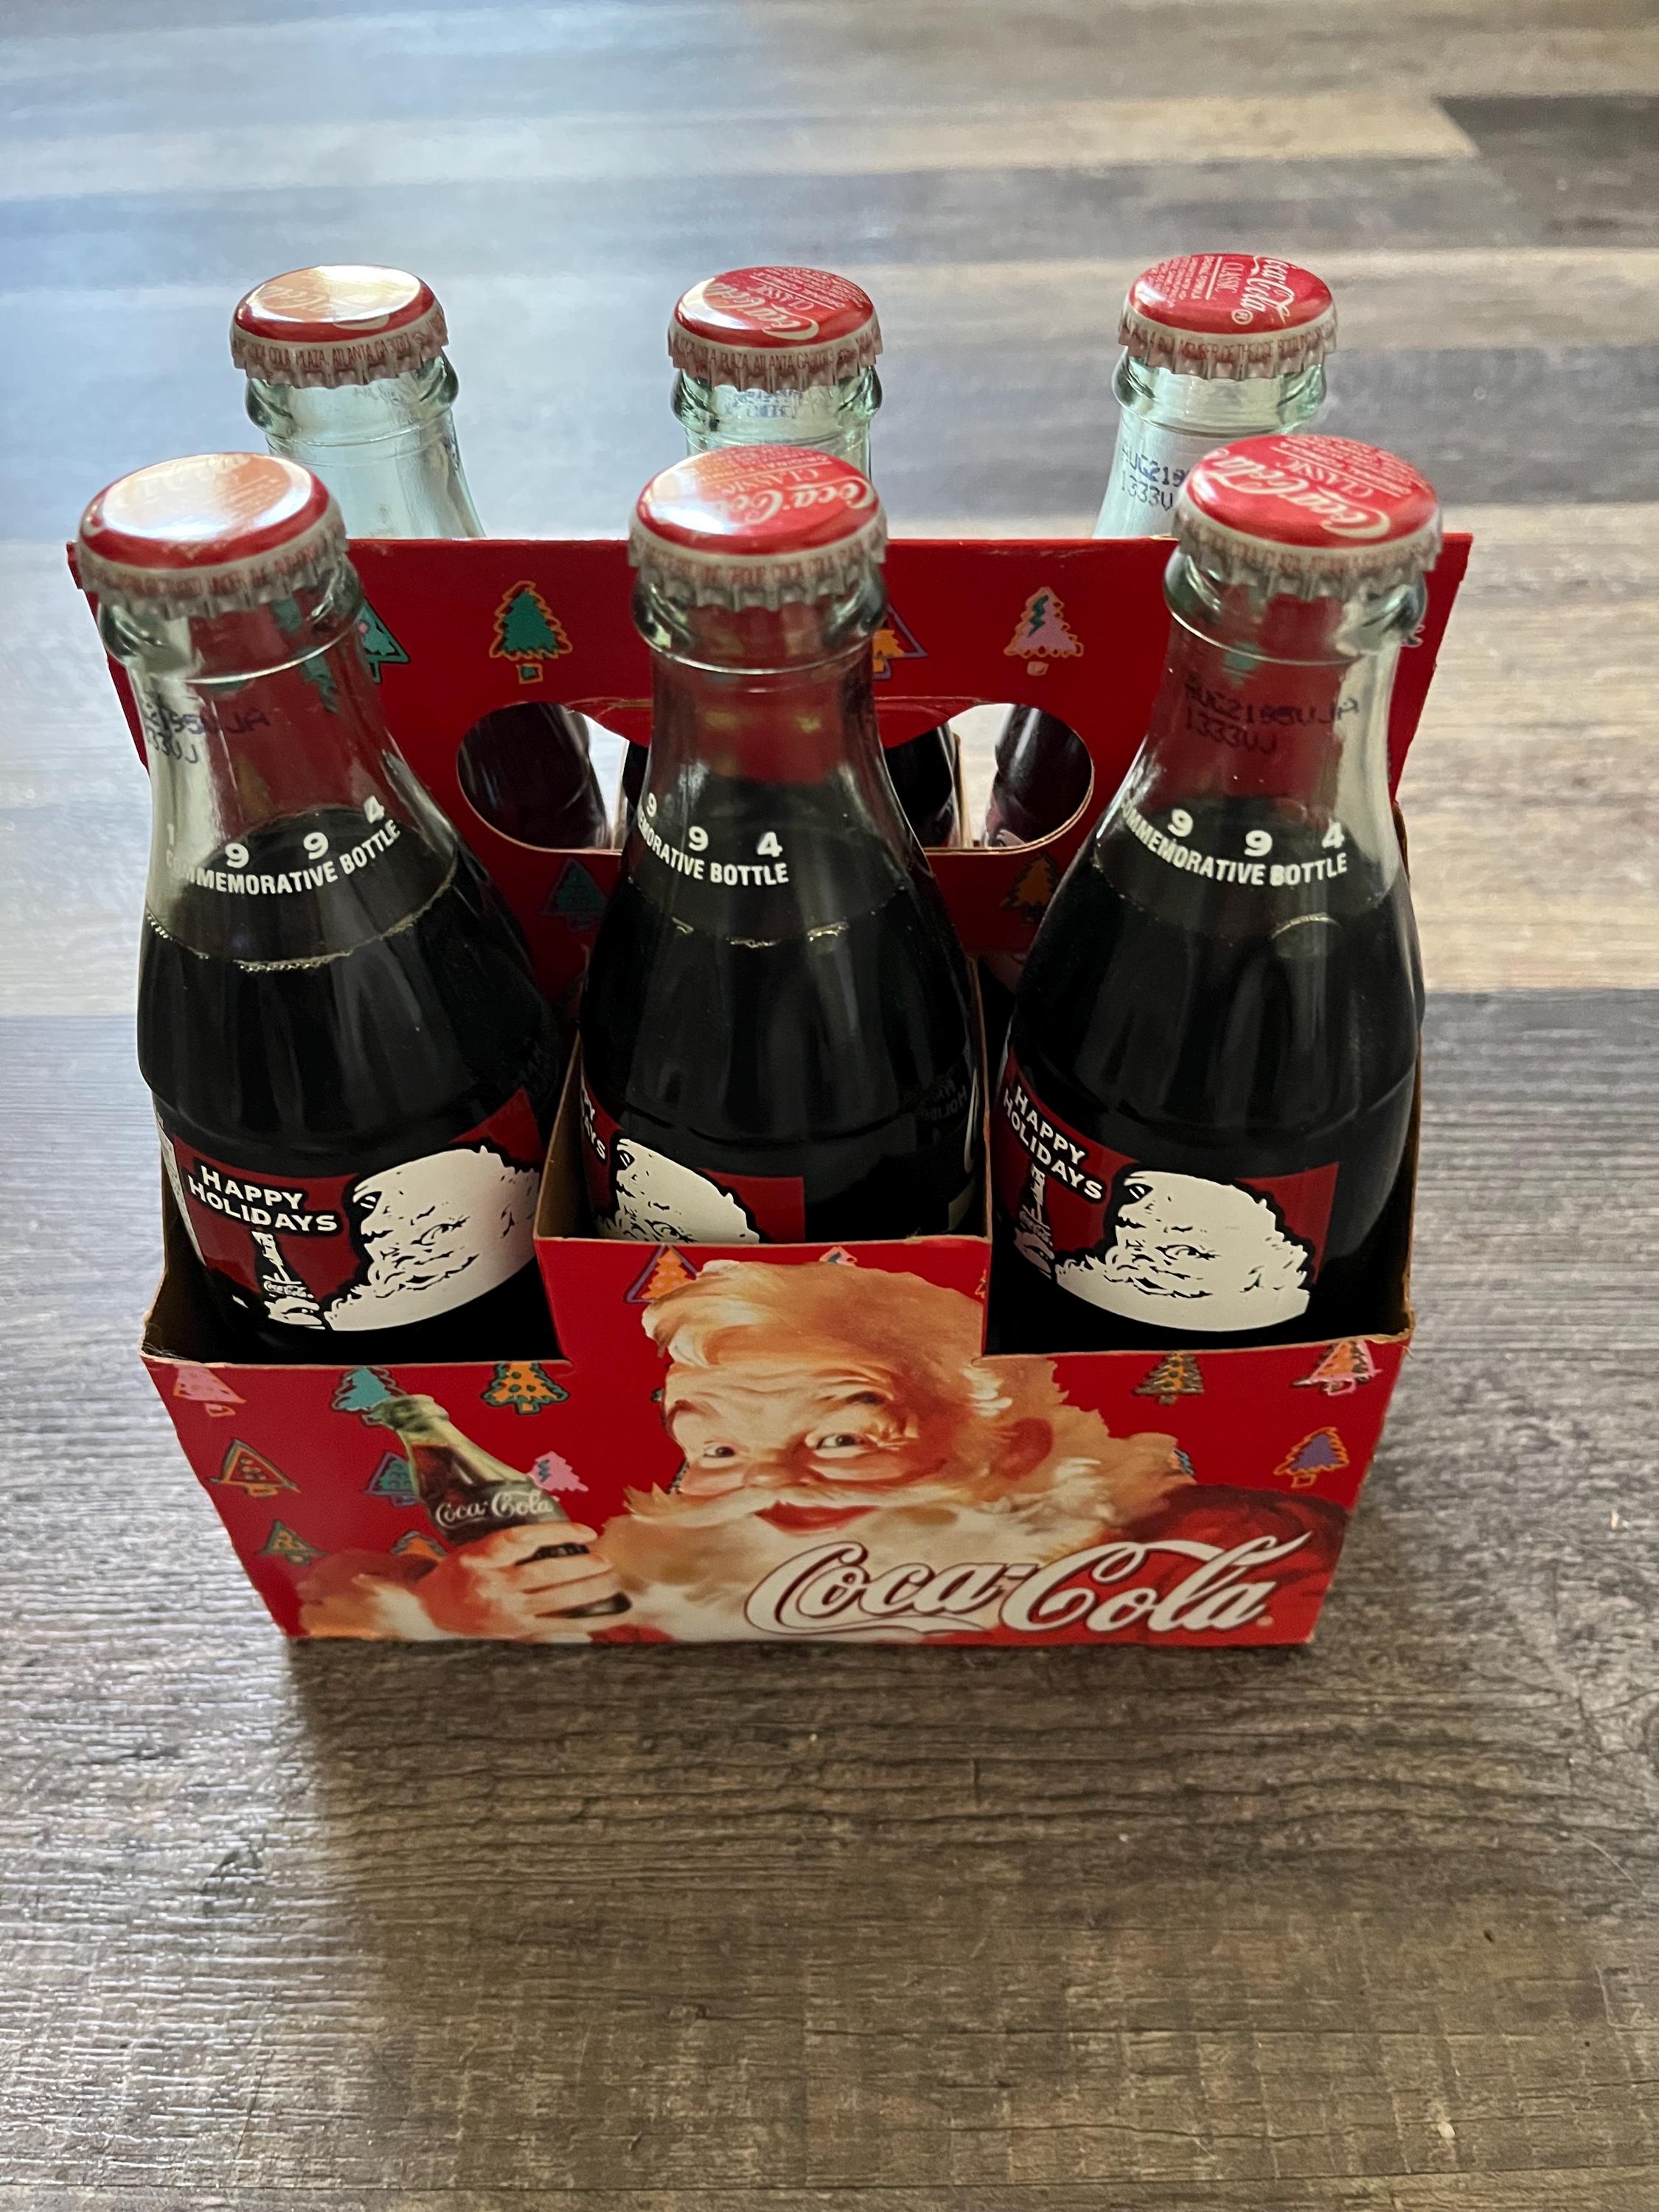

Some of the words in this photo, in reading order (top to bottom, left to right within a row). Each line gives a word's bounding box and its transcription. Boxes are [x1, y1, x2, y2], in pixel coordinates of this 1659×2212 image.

[224, 843, 250, 869] 9
[303, 832, 329, 860] 9
[364, 795, 385, 824] 4
[338, 819, 401, 875] BOTTLE
[646, 792, 658, 818] 9
[688, 825, 709, 852] 9
[757, 831, 784, 858] 4
[1167, 808, 1194, 838] 9
[1244, 830, 1273, 857] 9
[1321, 819, 1346, 849] 4
[709, 861, 790, 886] BOTTLE
[1269, 852, 1348, 887] BOTTLE
[1004, 1088, 1103, 1200] HOLIDAYS
[1015, 1085, 1086, 1166] HAPPY
[187, 1173, 338, 1232] HOLIDAYS
[201, 1164, 304, 1210] HAPPY
[435, 1489, 554, 1528] Coca-Cola
[743, 1529, 1313, 1638] Coca-Cola
